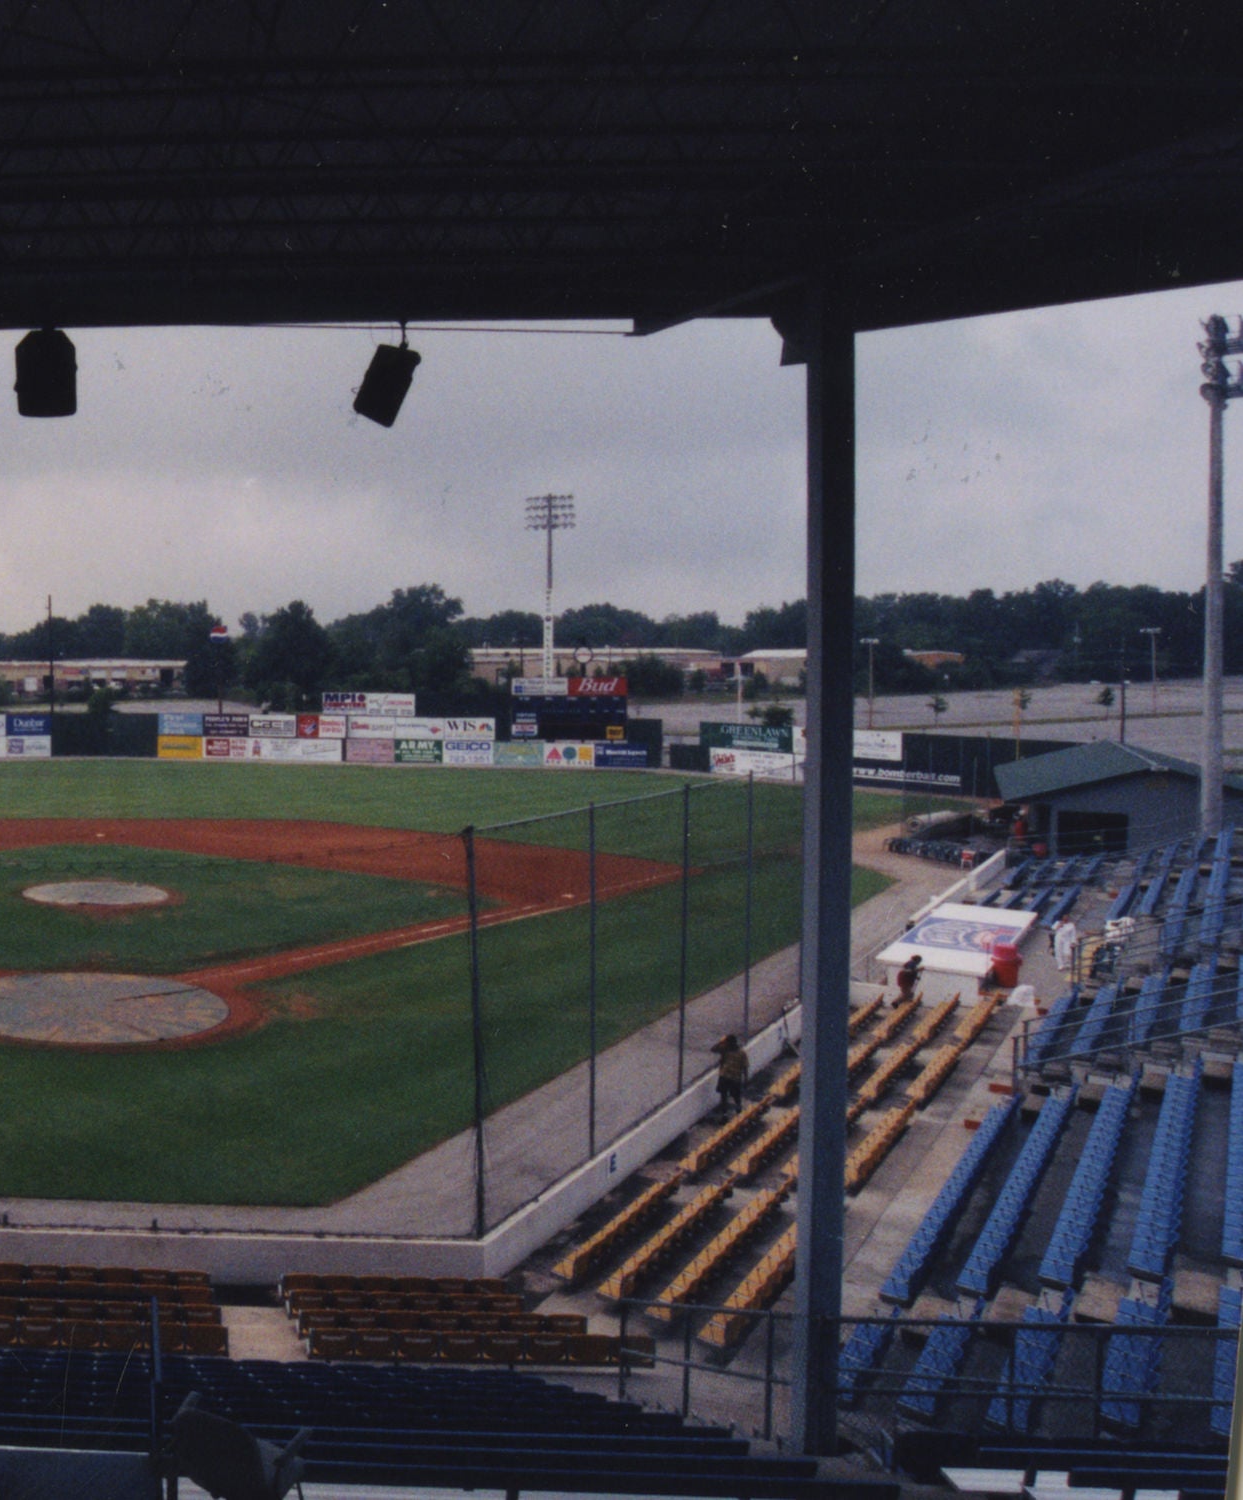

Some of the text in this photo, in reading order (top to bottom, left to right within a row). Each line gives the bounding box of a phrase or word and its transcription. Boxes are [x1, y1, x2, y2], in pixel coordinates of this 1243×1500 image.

[578, 678, 618, 691] Bud
[325, 692, 356, 702] MPI
[447, 721, 477, 732] WIS
[720, 725, 789, 737] GREENLAWN
[445, 741, 490, 751] GEICO
